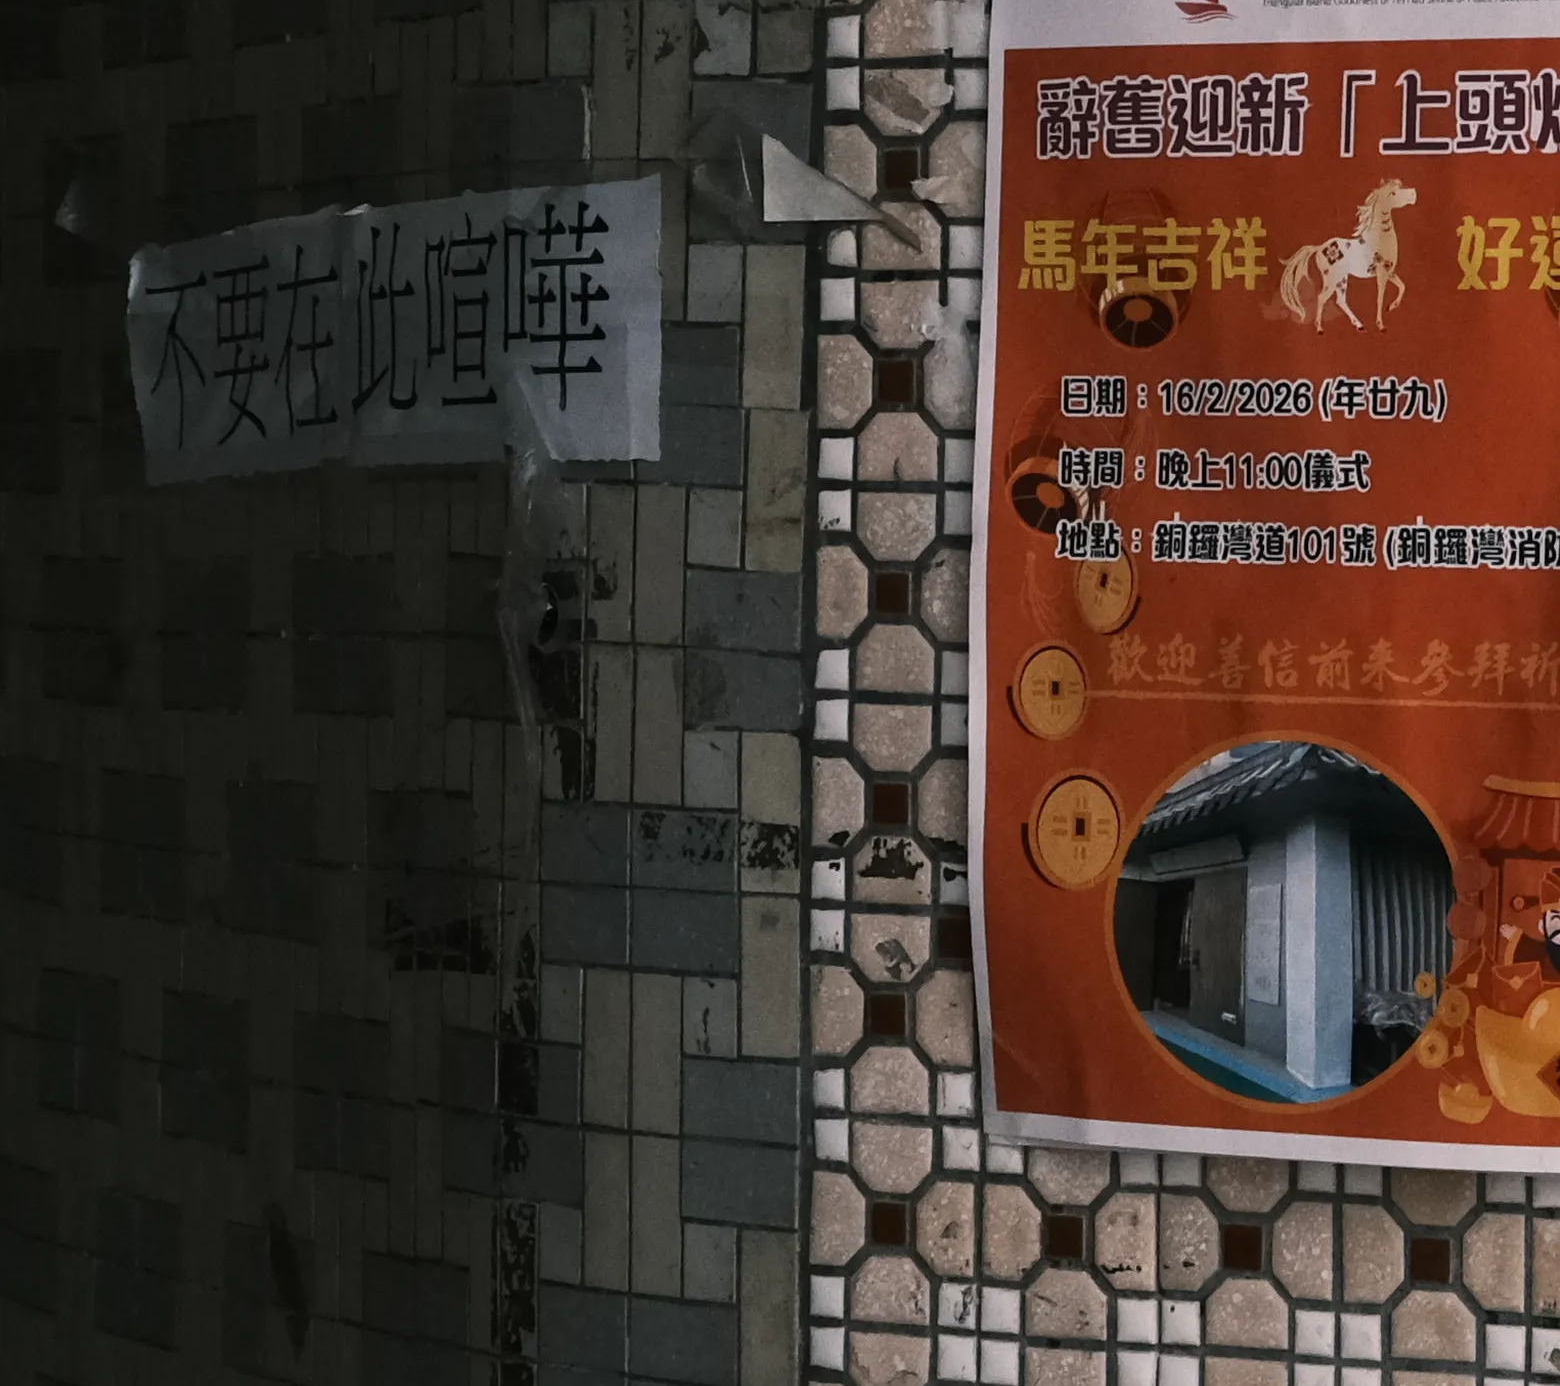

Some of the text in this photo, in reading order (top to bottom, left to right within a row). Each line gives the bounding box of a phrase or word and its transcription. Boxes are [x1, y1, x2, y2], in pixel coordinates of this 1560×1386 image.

[144, 200, 611, 451] 不要在此喧嘩
[1016, 216, 1270, 293] 馬年吉祥
